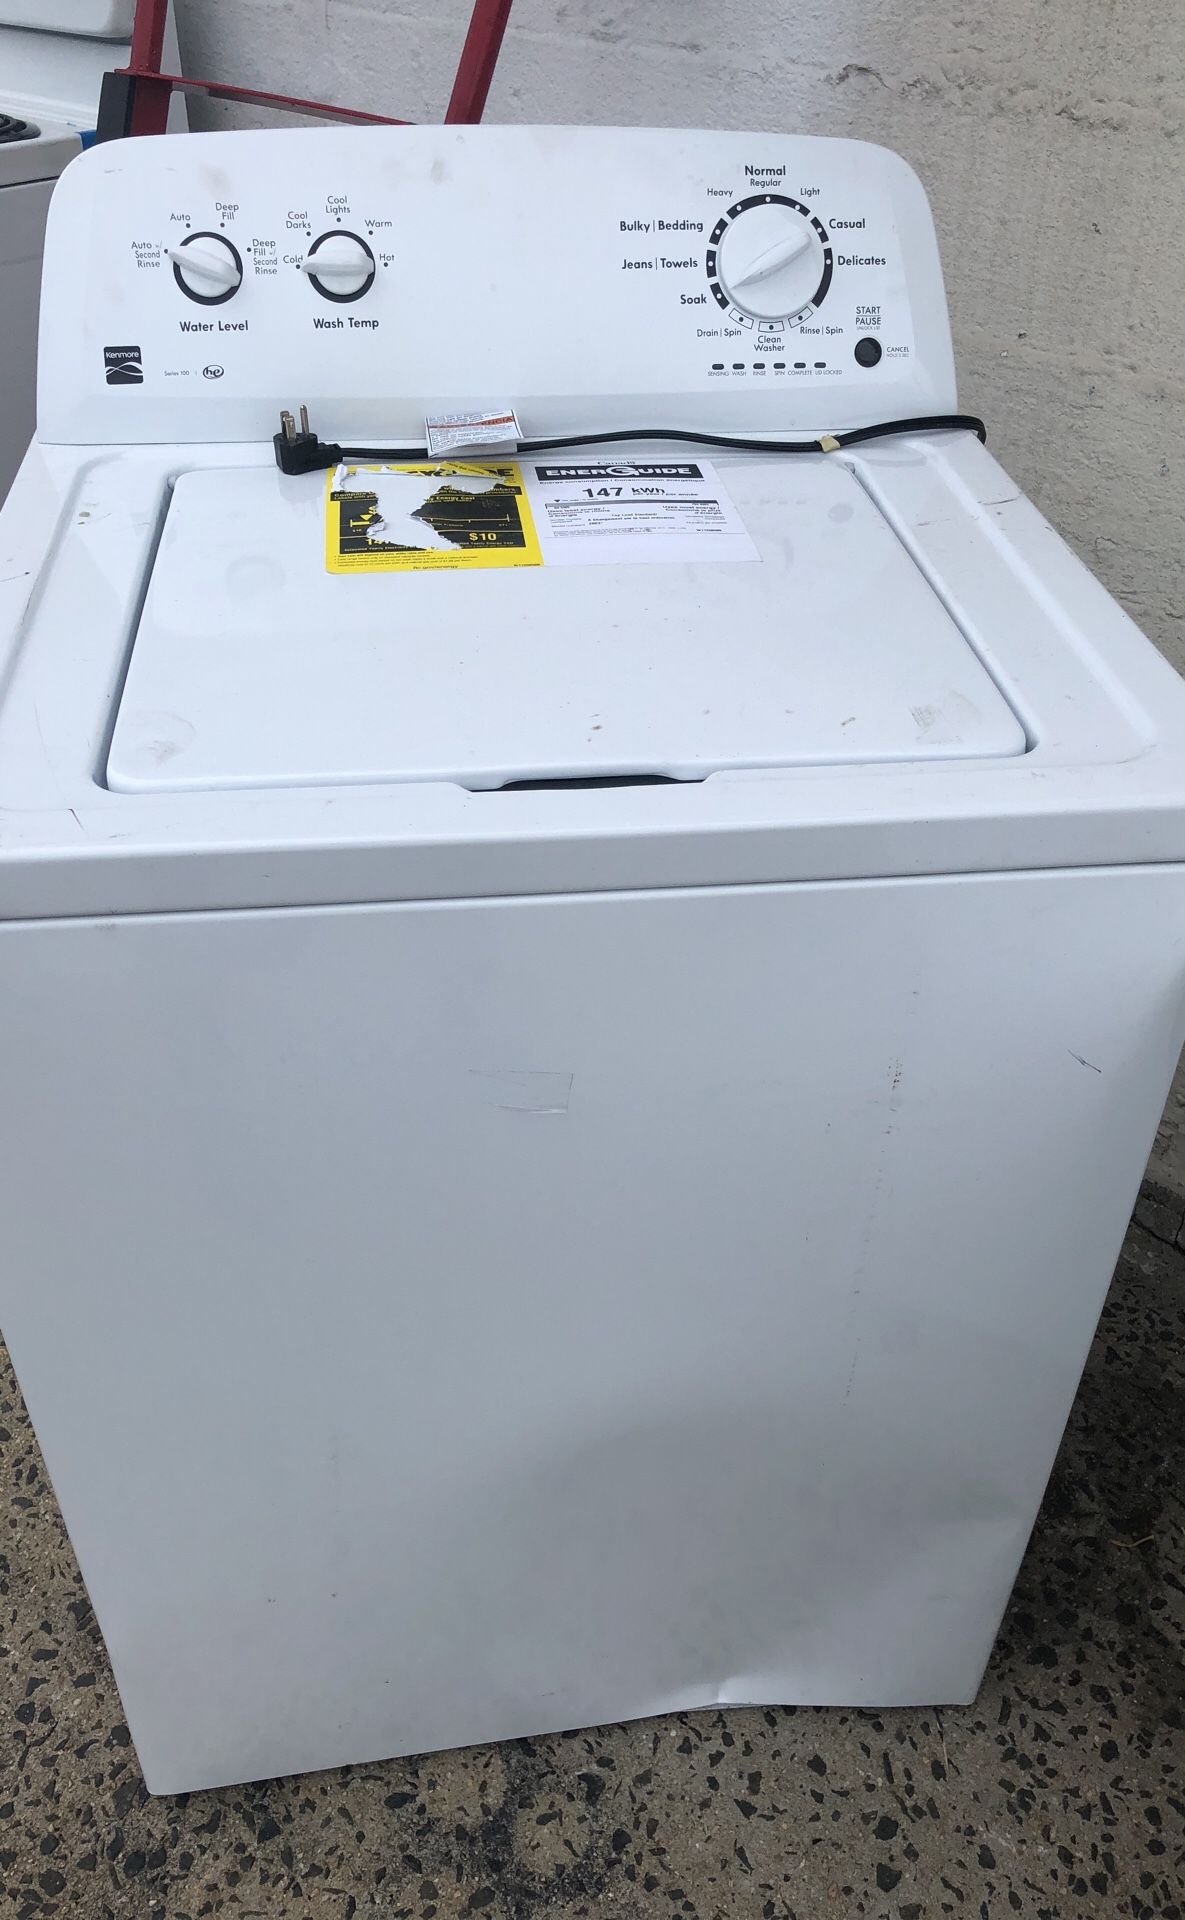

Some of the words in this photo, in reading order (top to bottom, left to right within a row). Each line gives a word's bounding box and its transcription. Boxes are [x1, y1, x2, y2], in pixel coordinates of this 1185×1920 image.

[744, 165, 787, 176] Normal
[750, 178, 782, 188] Regular
[707, 188, 734, 198] Heavy
[800, 187, 820, 197] Light
[327, 195, 348, 205] Cool
[215, 202, 240, 213] Deep
[325, 204, 351, 214] Lights
[170, 212, 191, 221] Auto
[222, 211, 235, 221] Fill
[287, 211, 308, 220] Cool
[286, 219, 312, 229] Darks
[364, 219, 393, 229] Warm
[619, 220, 650, 233] Bulky
[658, 220, 704, 233] Bedding
[829, 218, 866, 229] Casual
[131, 241, 153, 250] Auto
[252, 238, 276, 249] Deep
[134, 249, 161, 259] Second
[253, 247, 267, 256] Fill
[252, 256, 278, 266] Second
[282, 255, 303, 265] Cold
[379, 253, 395, 263] Hot
[837, 255, 887, 266] Delicates
[137, 259, 161, 268] Rinse
[621, 259, 653, 270] Jeans
[660, 257, 699, 269] Towels
[254, 266, 278, 275] Rinse
[680, 294, 708, 305] Soak
[855, 306, 881, 315] START
[179, 320, 215, 332] Water
[218, 320, 249, 332] Level
[313, 318, 345, 330] Wash
[347, 317, 380, 330] Temp
[855, 316, 882, 326] PAUSE
[697, 327, 720, 338] Drain
[723, 327, 742, 338] Spin
[800, 325, 821, 335] Rinse
[825, 325, 844, 336] Spin
[757, 335, 782, 344] Clean
[753, 343, 786, 352] Washer
[105, 351, 140, 359] Kenmore
[545, 466, 693, 477] ENERGUIDE
[582, 487, 624, 498] 147
[468, 532, 497, 542] $10
